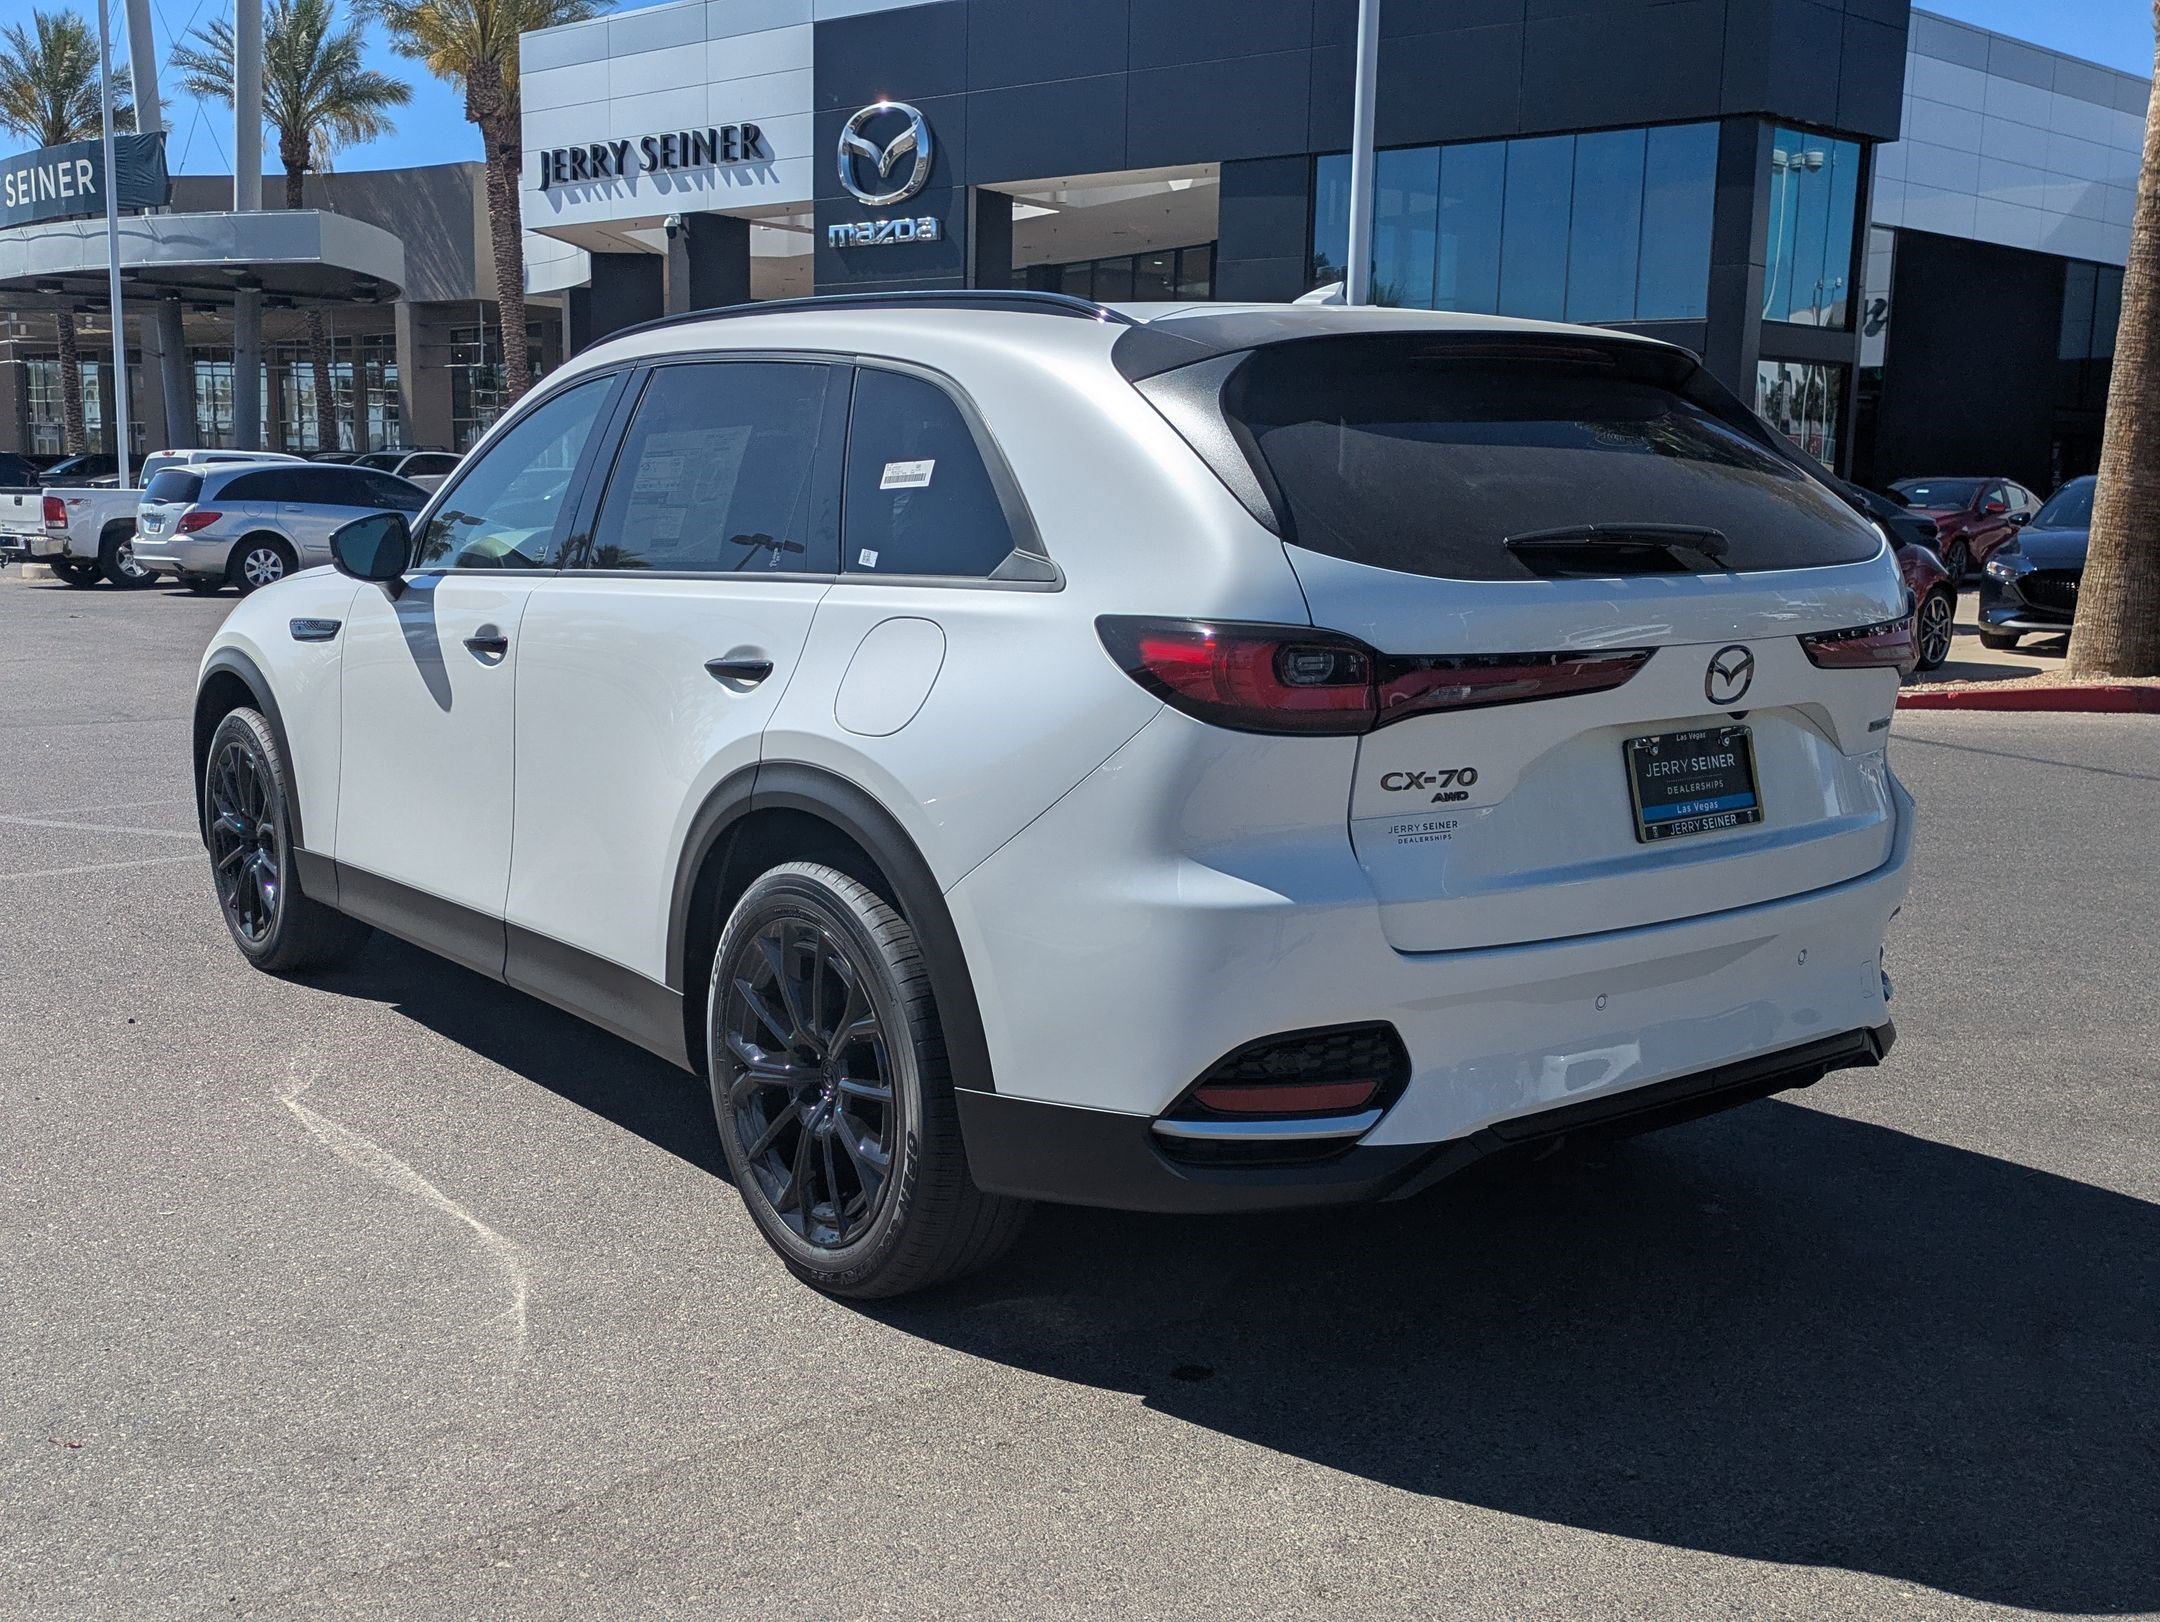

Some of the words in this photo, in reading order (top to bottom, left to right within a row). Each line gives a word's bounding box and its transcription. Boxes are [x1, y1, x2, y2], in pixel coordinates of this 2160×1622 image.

[538, 140, 630, 191] JERRY
[639, 123, 765, 172] SEINER
[5, 159, 96, 208] SEINER
[828, 217, 939, 248] mazda
[1689, 731, 1706, 740] Vegas
[1646, 759, 1688, 777] JERRY
[1691, 753, 1735, 771] SEINER
[1380, 767, 1478, 791] CX-70
[1667, 780, 1724, 795] DEALERSHIPS
[1431, 791, 1469, 803] AWD
[1677, 804, 1692, 814] Las
[1694, 801, 1719, 812] Vegas
[1388, 824, 1420, 834] JERRY
[1423, 820, 1458, 831] SEINER
[1670, 821, 1700, 836] JERRY
[1702, 814, 1738, 830] SEINER
[1398, 834, 1452, 845] DEALERSHIPS
